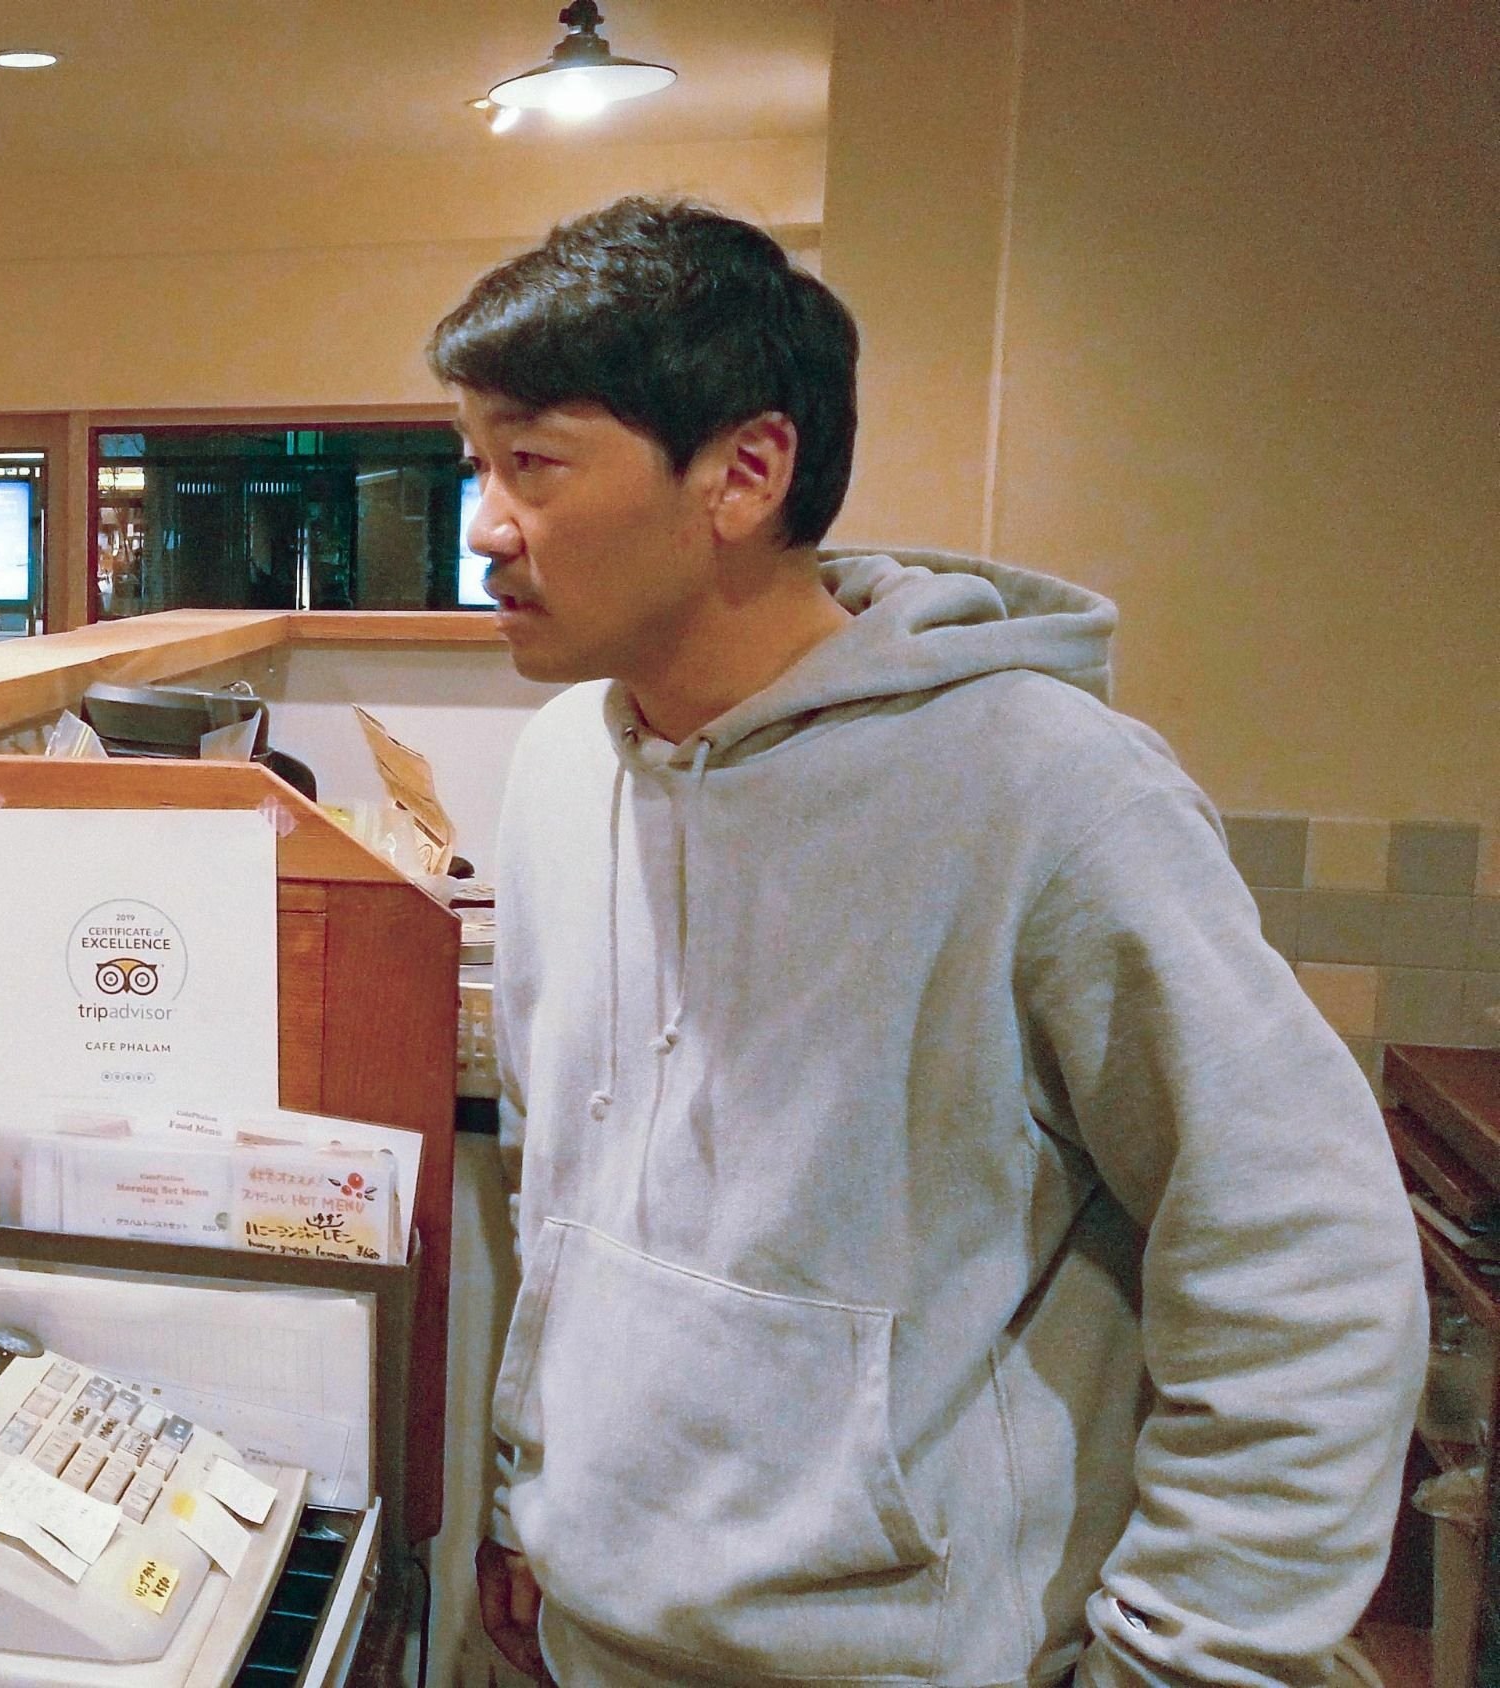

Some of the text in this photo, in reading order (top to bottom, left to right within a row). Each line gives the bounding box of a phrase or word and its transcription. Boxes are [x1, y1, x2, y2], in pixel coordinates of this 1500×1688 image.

[116, 913, 136, 922] 2019
[88, 927, 165, 937] CERTIFICATE of
[81, 937, 171, 950] EXCELLENCE
[77, 1003, 173, 1022] tripadvisor
[85, 1041, 171, 1053] CAFE PHALAM
[168, 1120, 222, 1136] Food Menu
[116, 1184, 209, 1197] Morning Set Menu
[291, 1194, 318, 1208] HOT
[321, 1197, 366, 1214] MENU
[247, 1239, 276, 1252] honey
[280, 1243, 312, 1256] ginger
[315, 1245, 350, 1260] lemon
